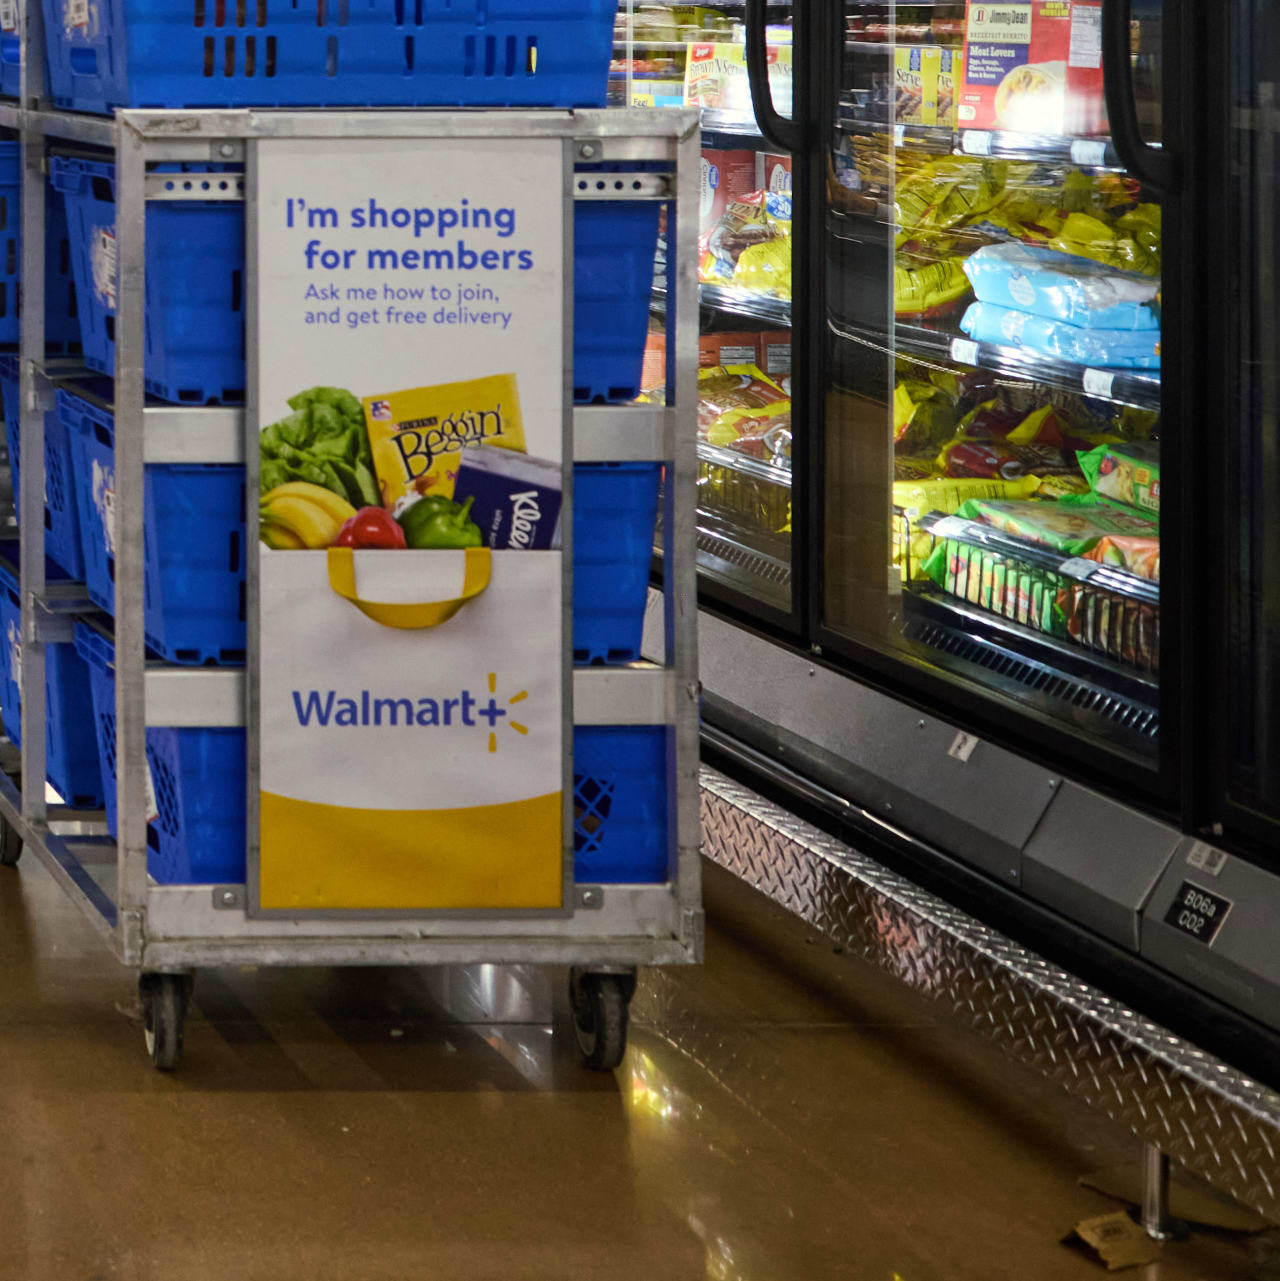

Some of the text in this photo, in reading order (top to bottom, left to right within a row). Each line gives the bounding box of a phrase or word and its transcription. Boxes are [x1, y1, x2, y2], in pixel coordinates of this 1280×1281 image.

[990, 9, 1011, 25] Jimmy
[970, 46, 989, 56] Meat
[896, 69, 921, 87] Serve
[286, 199, 516, 238] I'm shopping
[305, 240, 534, 270] for members
[305, 283, 500, 305] Ask me how to join,
[305, 306, 512, 329] and get free delivery
[292, 689, 507, 727] Walmart+
[1184, 889, 1217, 918] B06a
